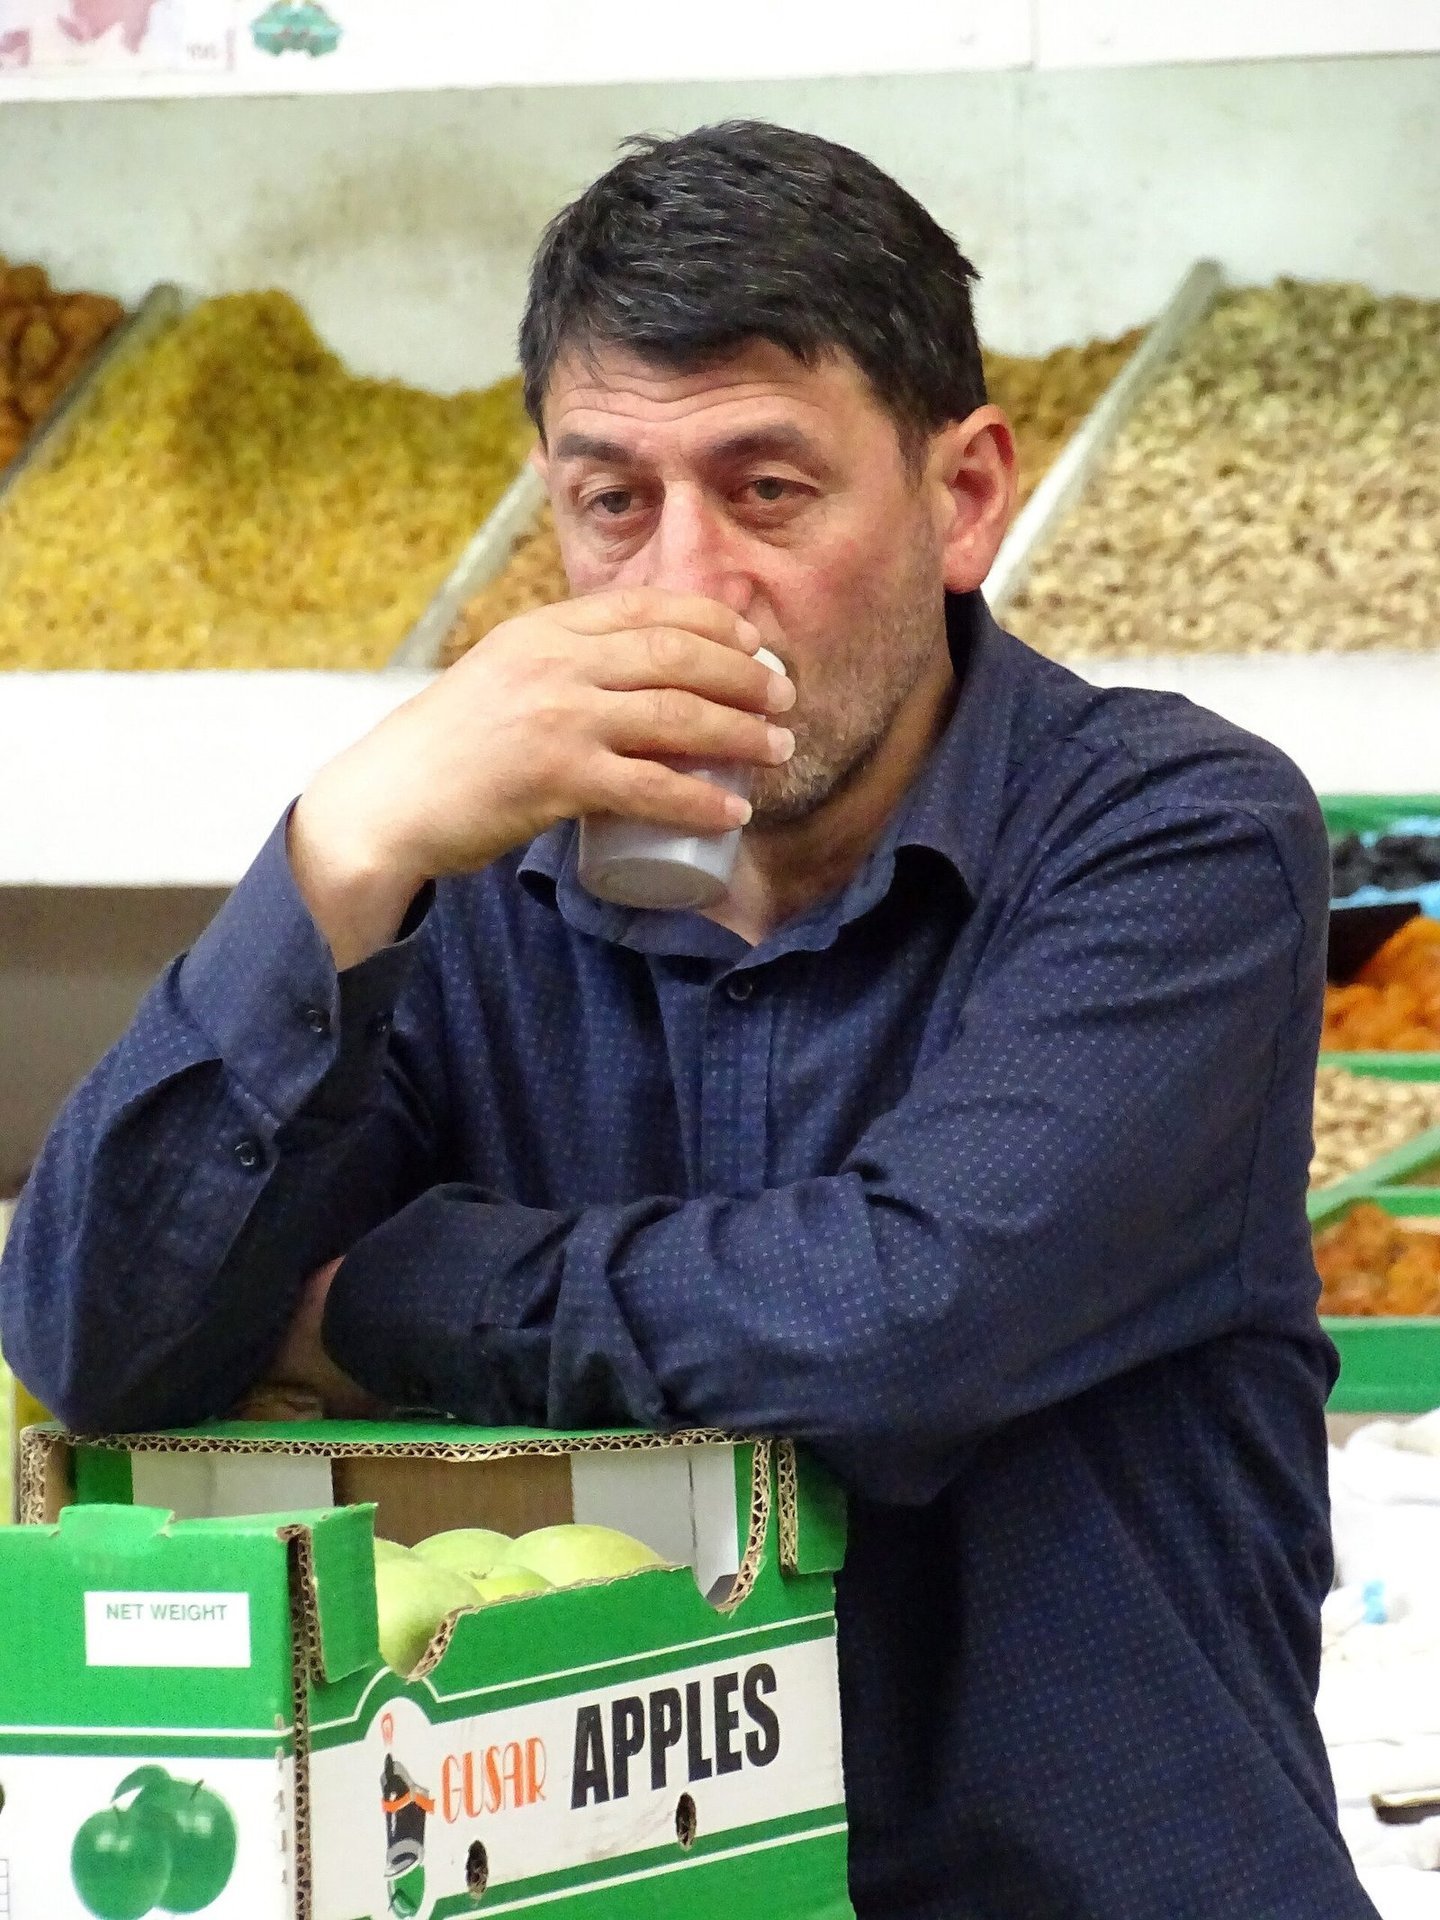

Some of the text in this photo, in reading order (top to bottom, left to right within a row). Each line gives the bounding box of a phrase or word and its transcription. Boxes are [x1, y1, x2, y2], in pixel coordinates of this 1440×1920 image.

[106, 1603, 228, 1621] NET WEIGHT
[441, 1663, 780, 1824] GUSAR APPLES
